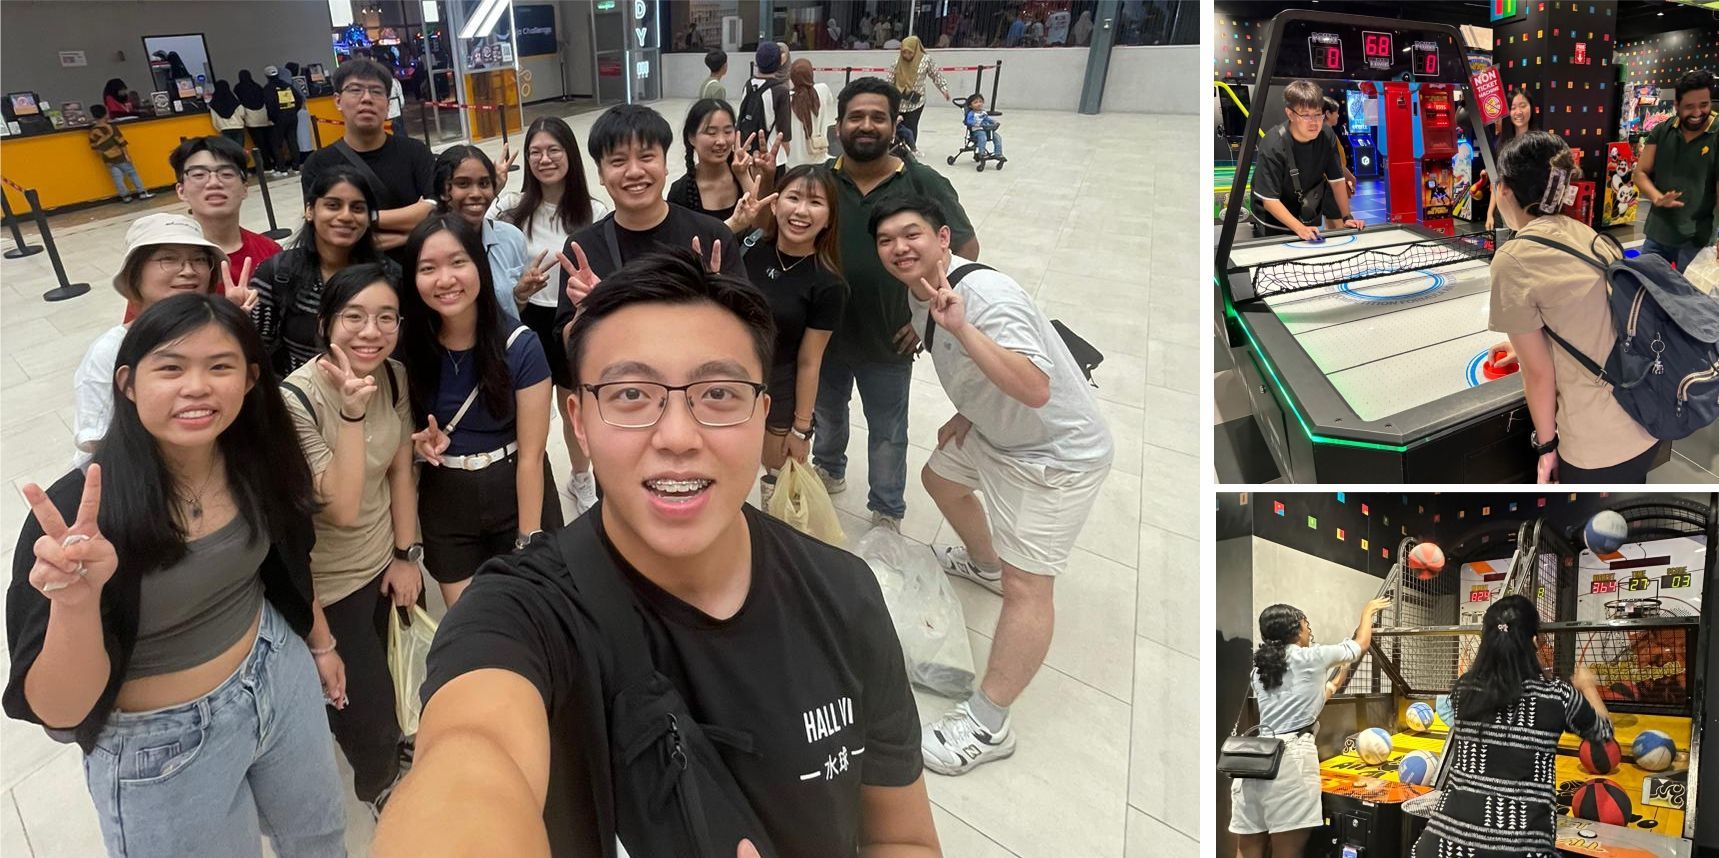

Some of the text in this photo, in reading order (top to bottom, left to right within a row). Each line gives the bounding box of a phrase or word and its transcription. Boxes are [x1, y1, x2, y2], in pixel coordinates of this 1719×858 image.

[1366, 36, 1390, 56] 68
[1328, 48, 1339, 68] 0
[1426, 55, 1436, 73] 0
[1474, 70, 1497, 86] NON
[1477, 80, 1498, 93] TICKET
[1479, 86, 1500, 98] MACHINE
[1593, 582, 1616, 593] 364
[1631, 579, 1648, 591] 27
[1672, 576, 1690, 587] 03
[803, 697, 854, 743] HALL VI
[824, 746, 849, 780] 水球
